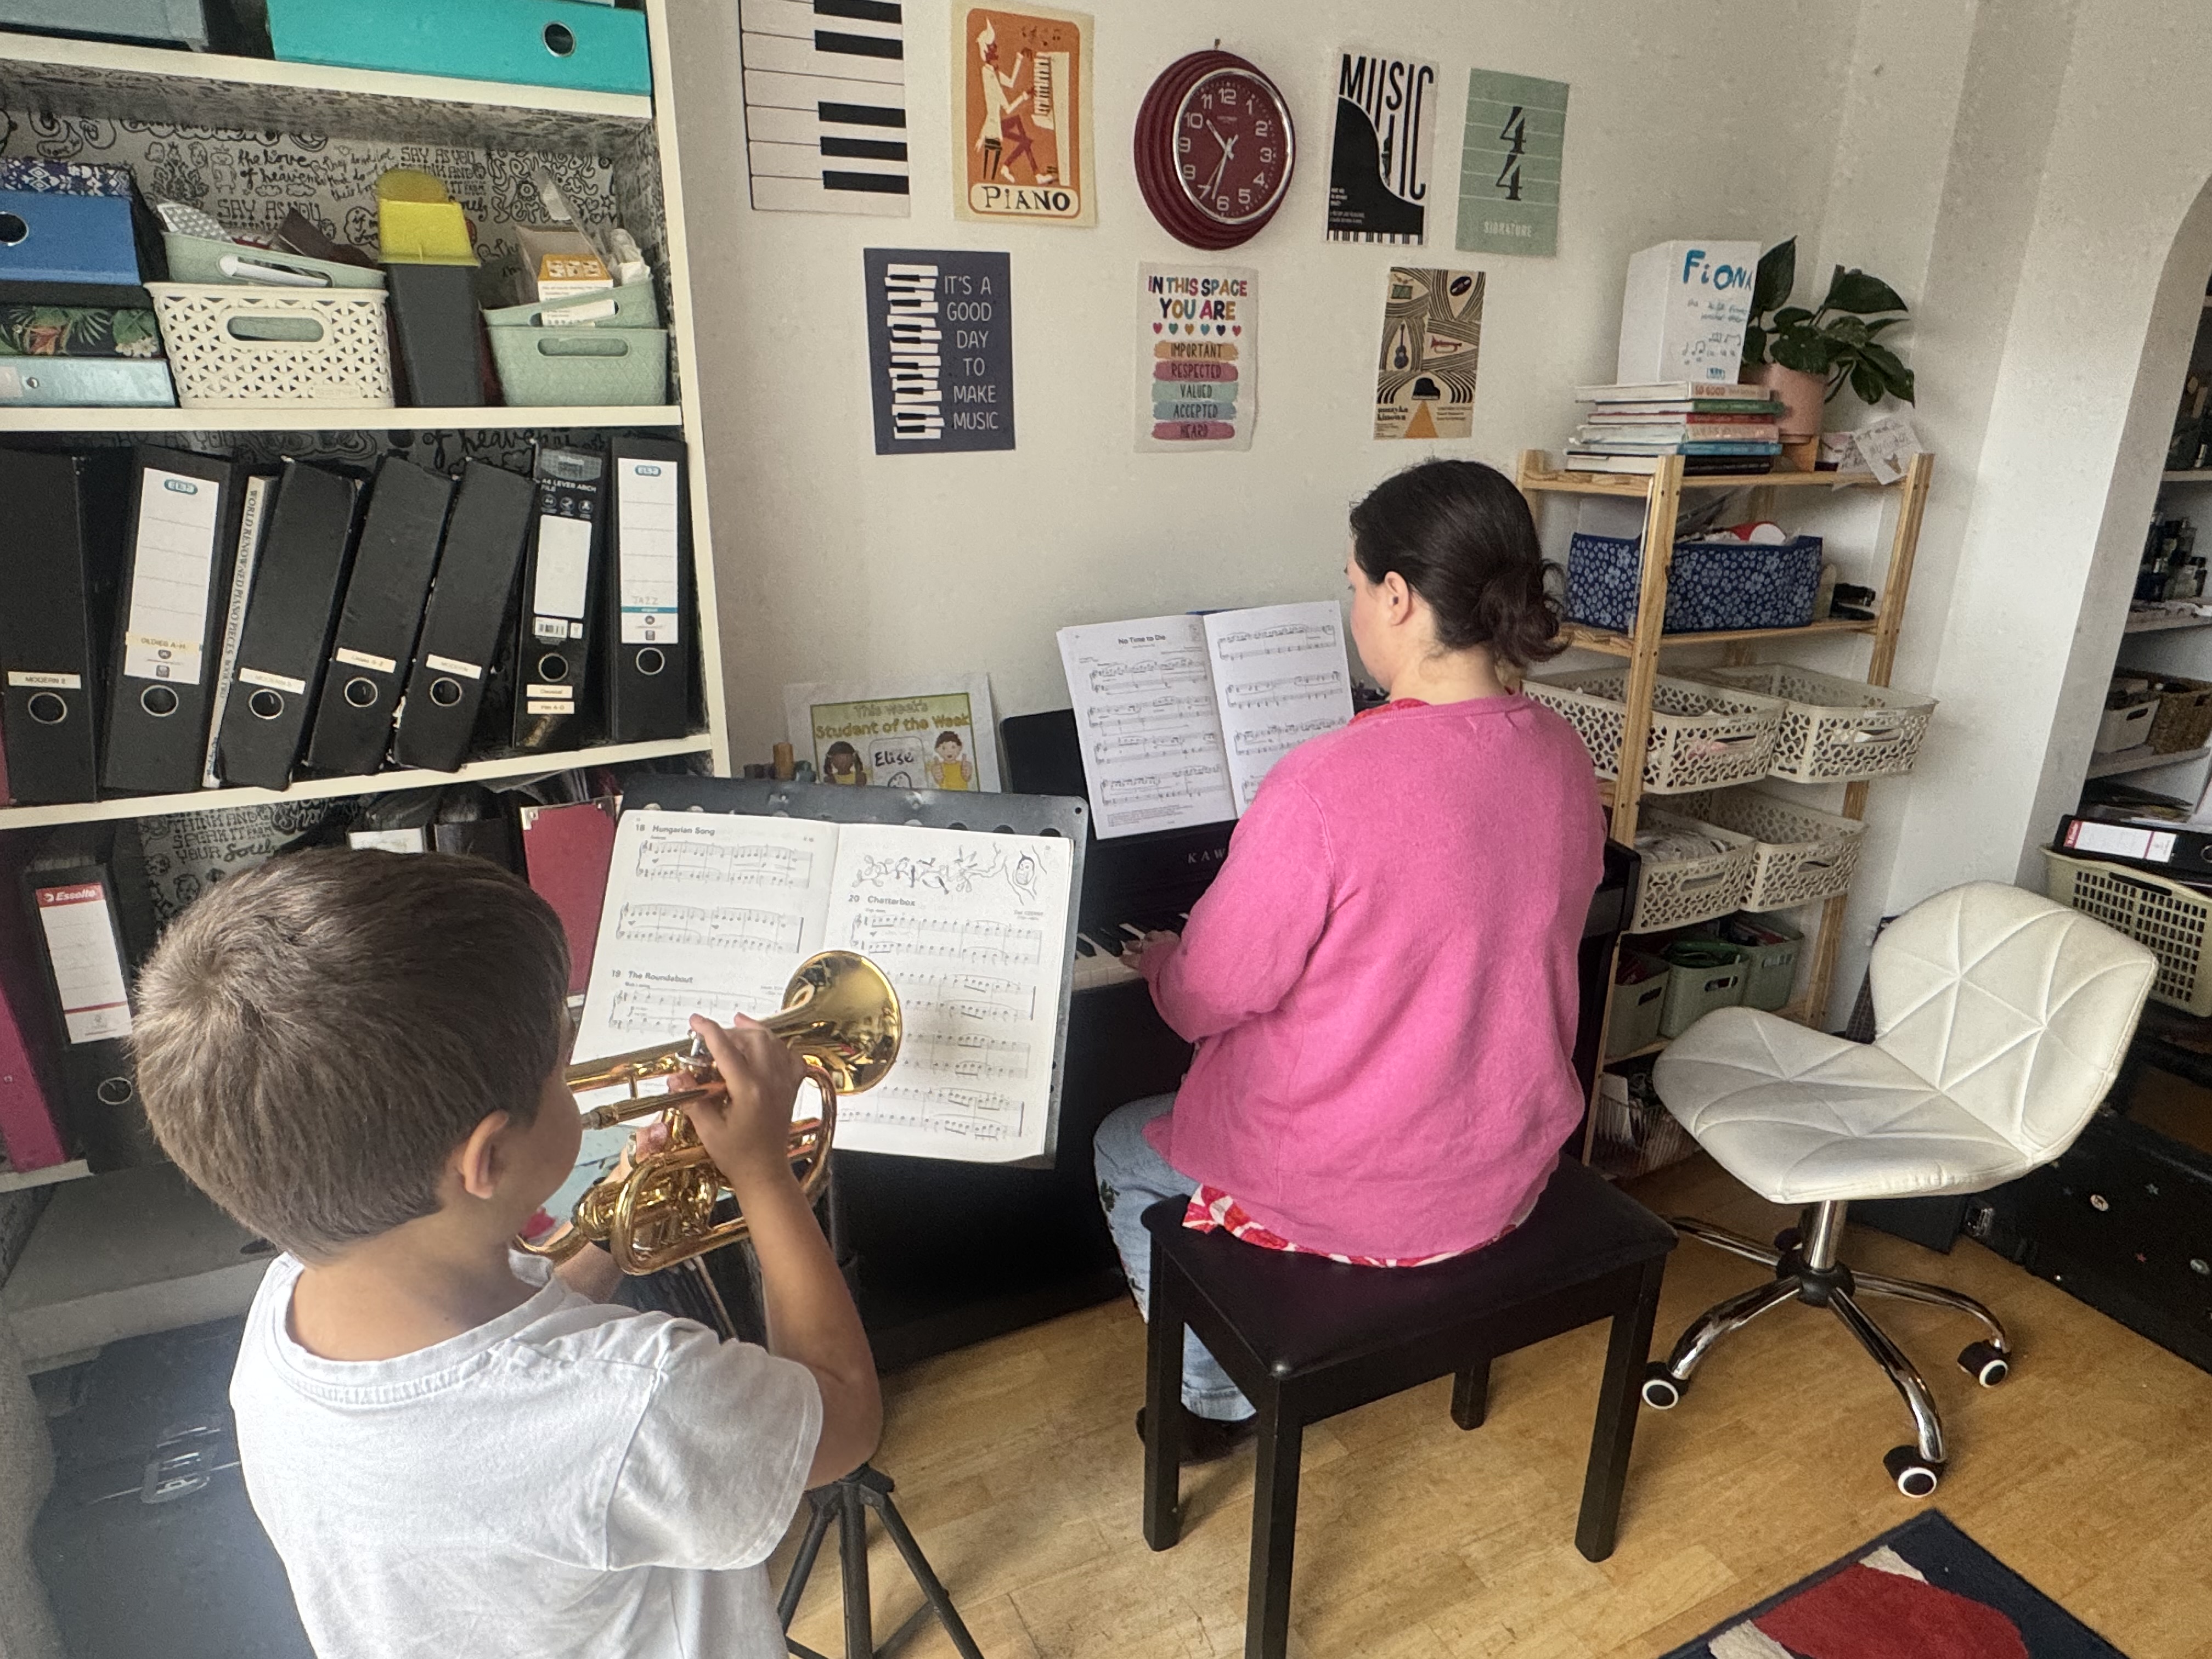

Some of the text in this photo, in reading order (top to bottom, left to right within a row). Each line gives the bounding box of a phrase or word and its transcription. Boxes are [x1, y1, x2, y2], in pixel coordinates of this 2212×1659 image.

[1201, 93, 1212, 110] 11
[1218, 88, 1236, 105] 12
[1246, 99, 1252, 114] 1
[1184, 112, 1203, 129] 10
[1255, 121, 1267, 136] 2
[1339, 53, 1434, 201] MUSIC
[1500, 106, 1526, 154] 4
[1180, 137, 1191, 153] 9
[401, 146, 428, 163] SAY
[436, 149, 450, 163] AS
[1260, 147, 1272, 162] 3
[1183, 164, 1195, 180] 8
[1254, 172, 1265, 185] 4
[1496, 154, 1523, 201] 4
[1197, 184, 1211, 199] 7
[1238, 188, 1250, 204] 5
[218, 199, 256, 219] SAY
[1217, 196, 1229, 211] 6
[945, 276, 992, 295] IT'S A
[1148, 276, 1248, 297] IN THIS SPACE
[947, 302, 992, 321] GOOD
[1160, 297, 1236, 320] YOU ARE
[957, 330, 989, 349] DAY
[1171, 343, 1223, 358] IMPORTANT
[963, 358, 985, 376] TO
[1172, 362, 1221, 379] RESPECTED
[953, 385, 996, 403] MAKE
[1180, 385, 1212, 398] VALUED
[1173, 404, 1218, 419] ACCEPTED
[953, 411, 998, 430] MUSIC
[1181, 424, 1210, 438] HEARD
[553, 480, 575, 488] LEVER
[577, 484, 597, 493] ARCH
[245, 490, 258, 527] WORLD
[236, 528, 252, 587] RENOWNED
[230, 588, 244, 621] PIANO
[225, 623, 238, 654] PIECES
[815, 713, 970, 739] Student of the Week
[874, 750, 914, 767] Elise
[226, 811, 258, 826] AND
[652, 825, 692, 834] Hungarian
[695, 827, 715, 836] Song
[175, 846, 222, 865] YOUR
[848, 894, 915, 906] 20 Chatterbox
[612, 969, 693, 984] 19 The Roundabout
